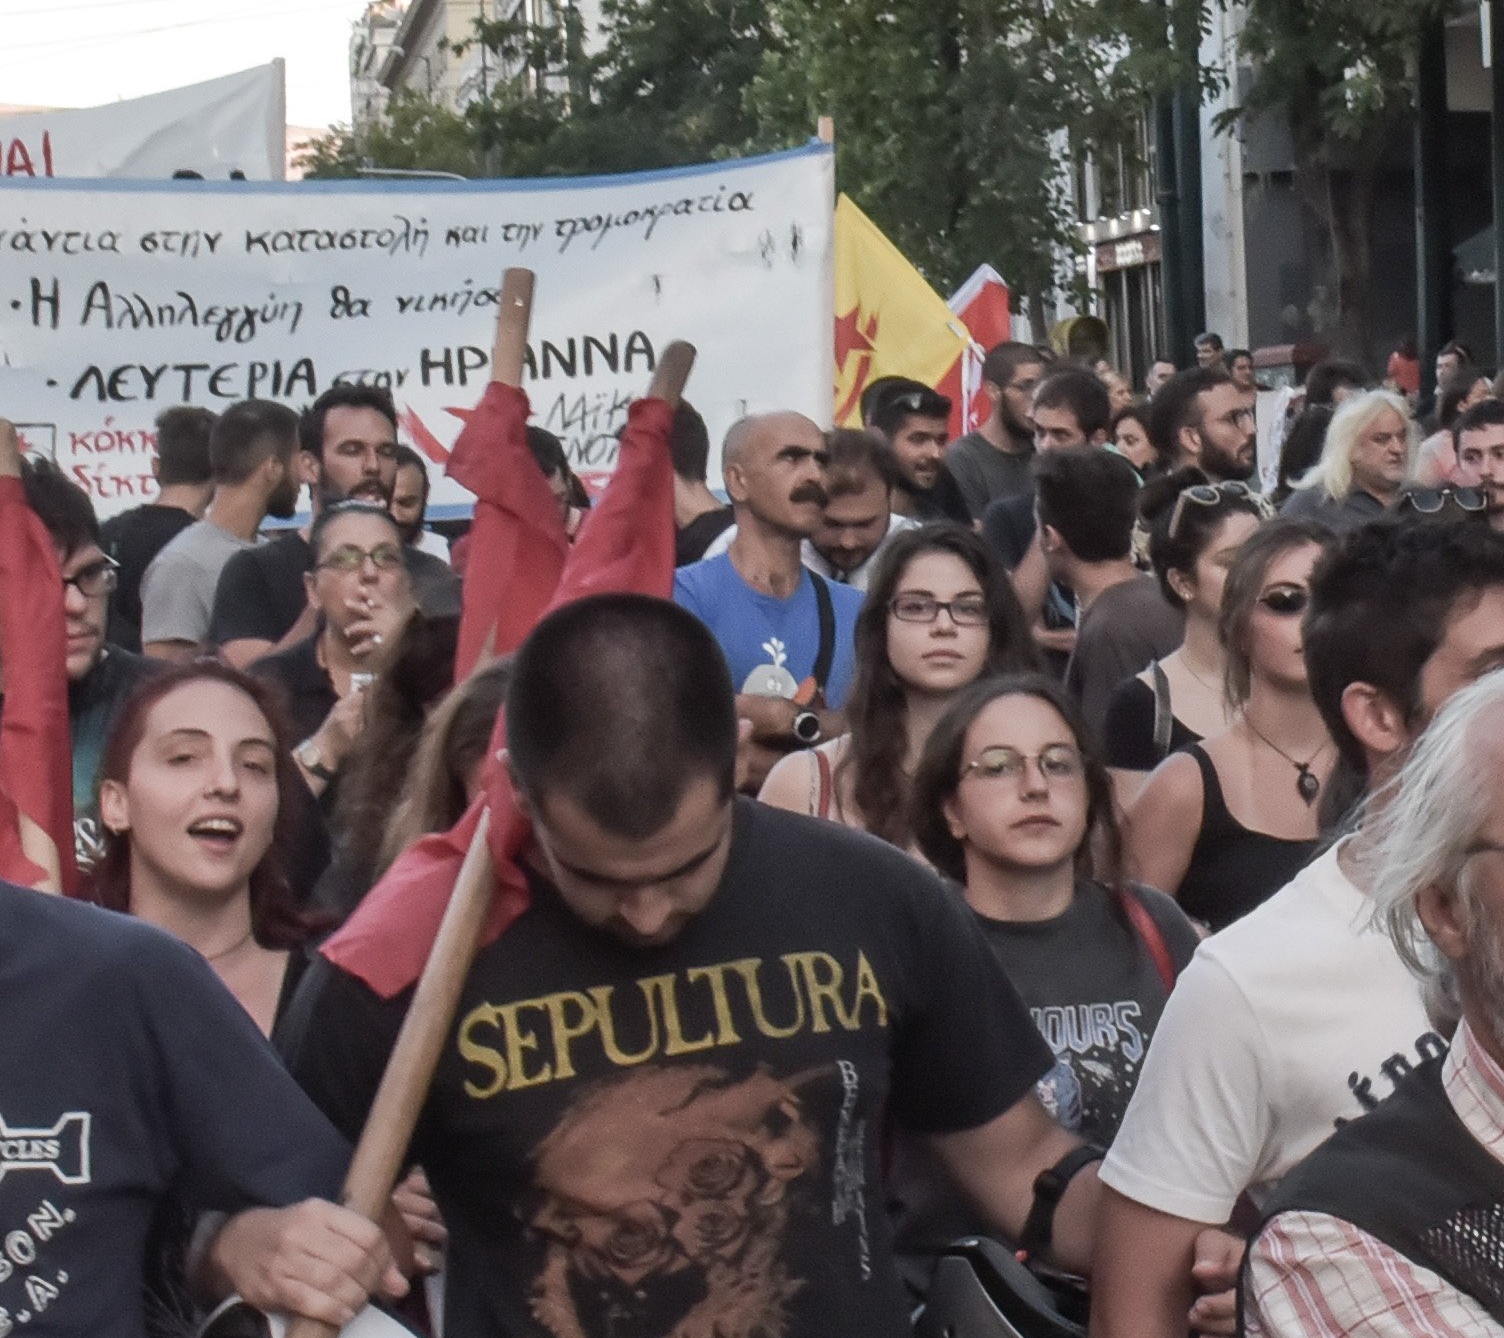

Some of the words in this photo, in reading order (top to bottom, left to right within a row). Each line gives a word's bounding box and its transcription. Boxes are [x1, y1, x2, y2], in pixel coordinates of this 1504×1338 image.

[69, 358, 317, 401] ΛΕΥΤΕΡΙΑ
[420, 330, 656, 386] ΗΡΑΝΝΑ
[457, 949, 888, 1099] SEPULTURA
[1030, 1000, 1144, 1063] OURS
